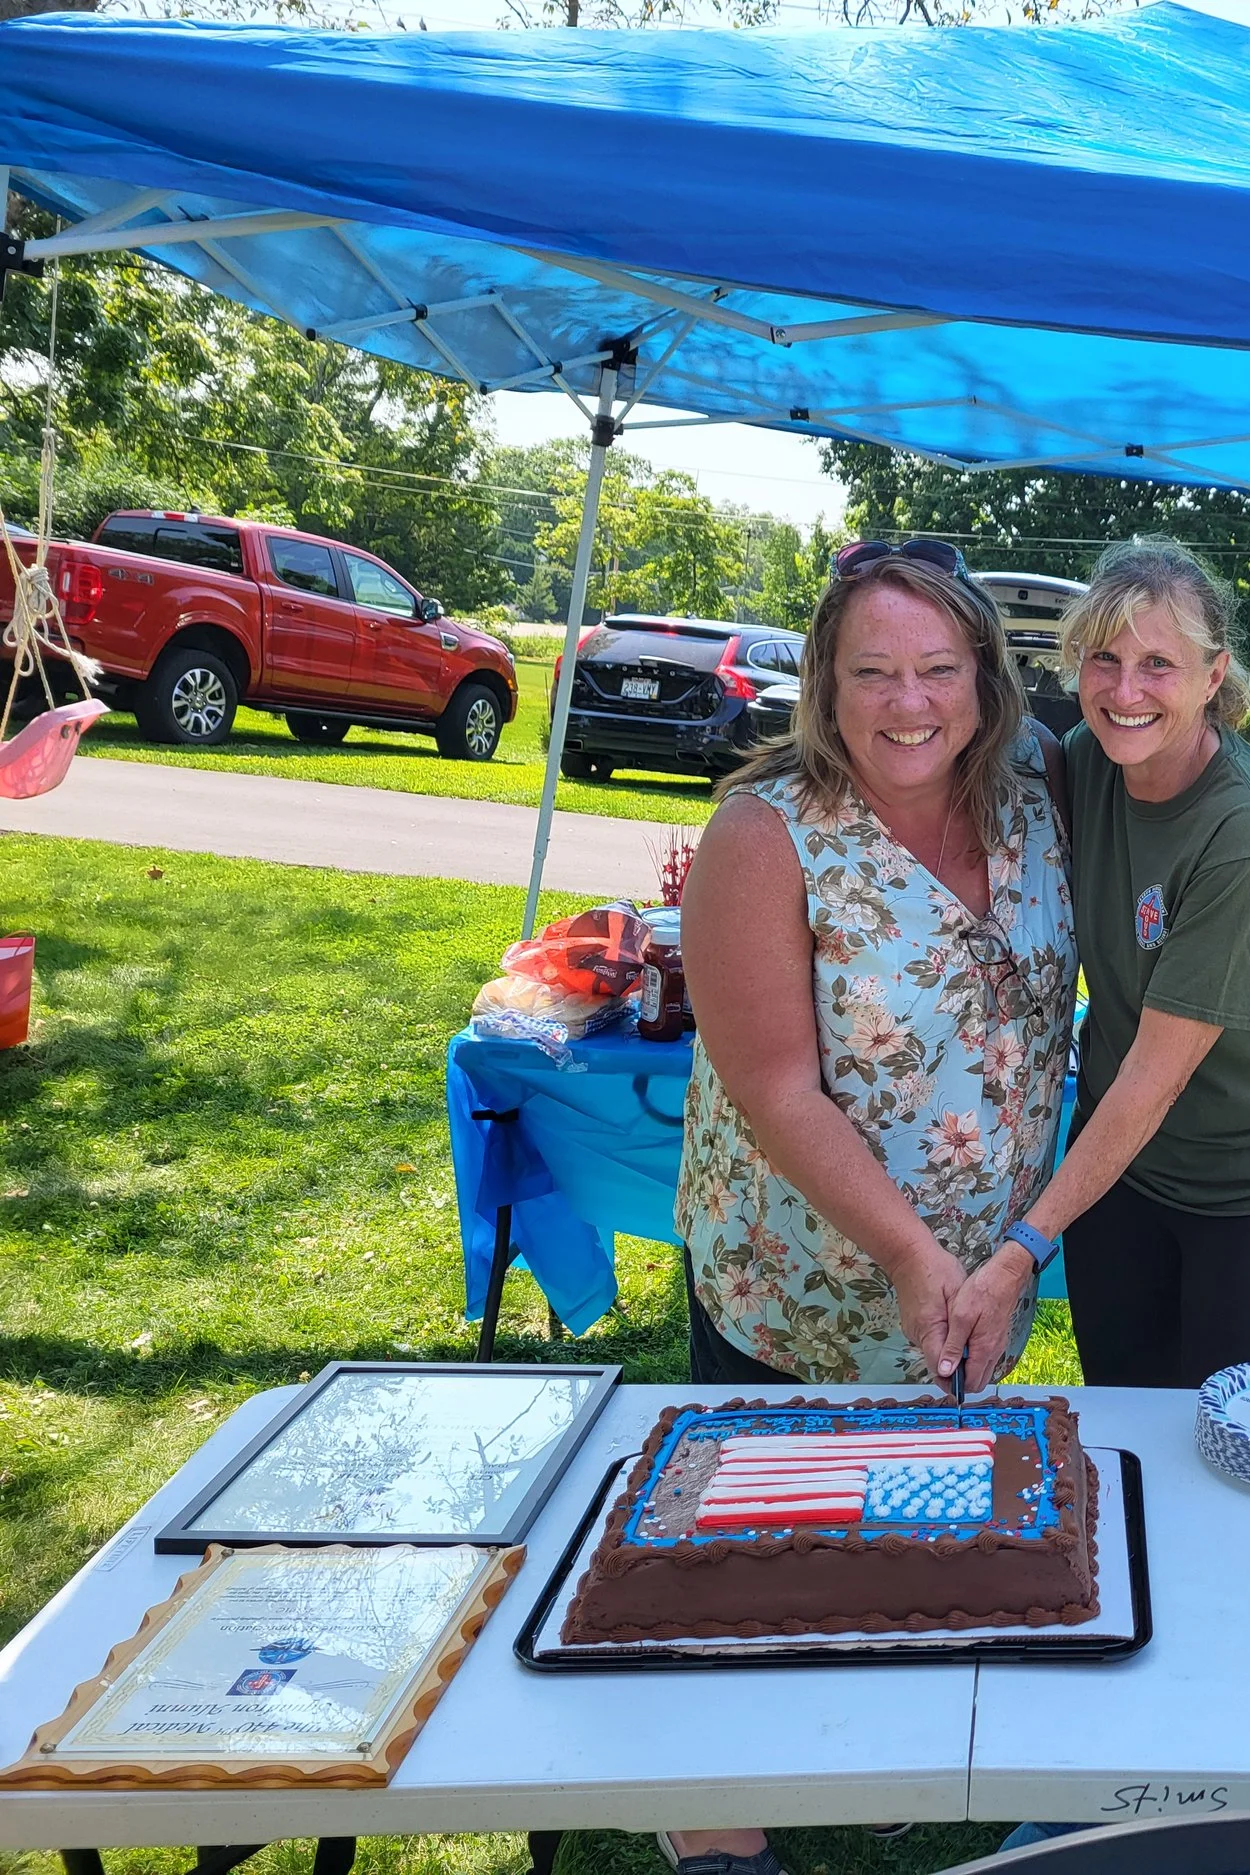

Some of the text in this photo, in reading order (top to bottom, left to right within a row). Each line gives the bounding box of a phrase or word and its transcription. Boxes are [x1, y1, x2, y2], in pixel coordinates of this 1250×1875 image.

[605, 663, 676, 677] VOLVO
[144, 1702, 332, 1717] Squadron Alumni
[119, 1722, 215, 1737] Medical
